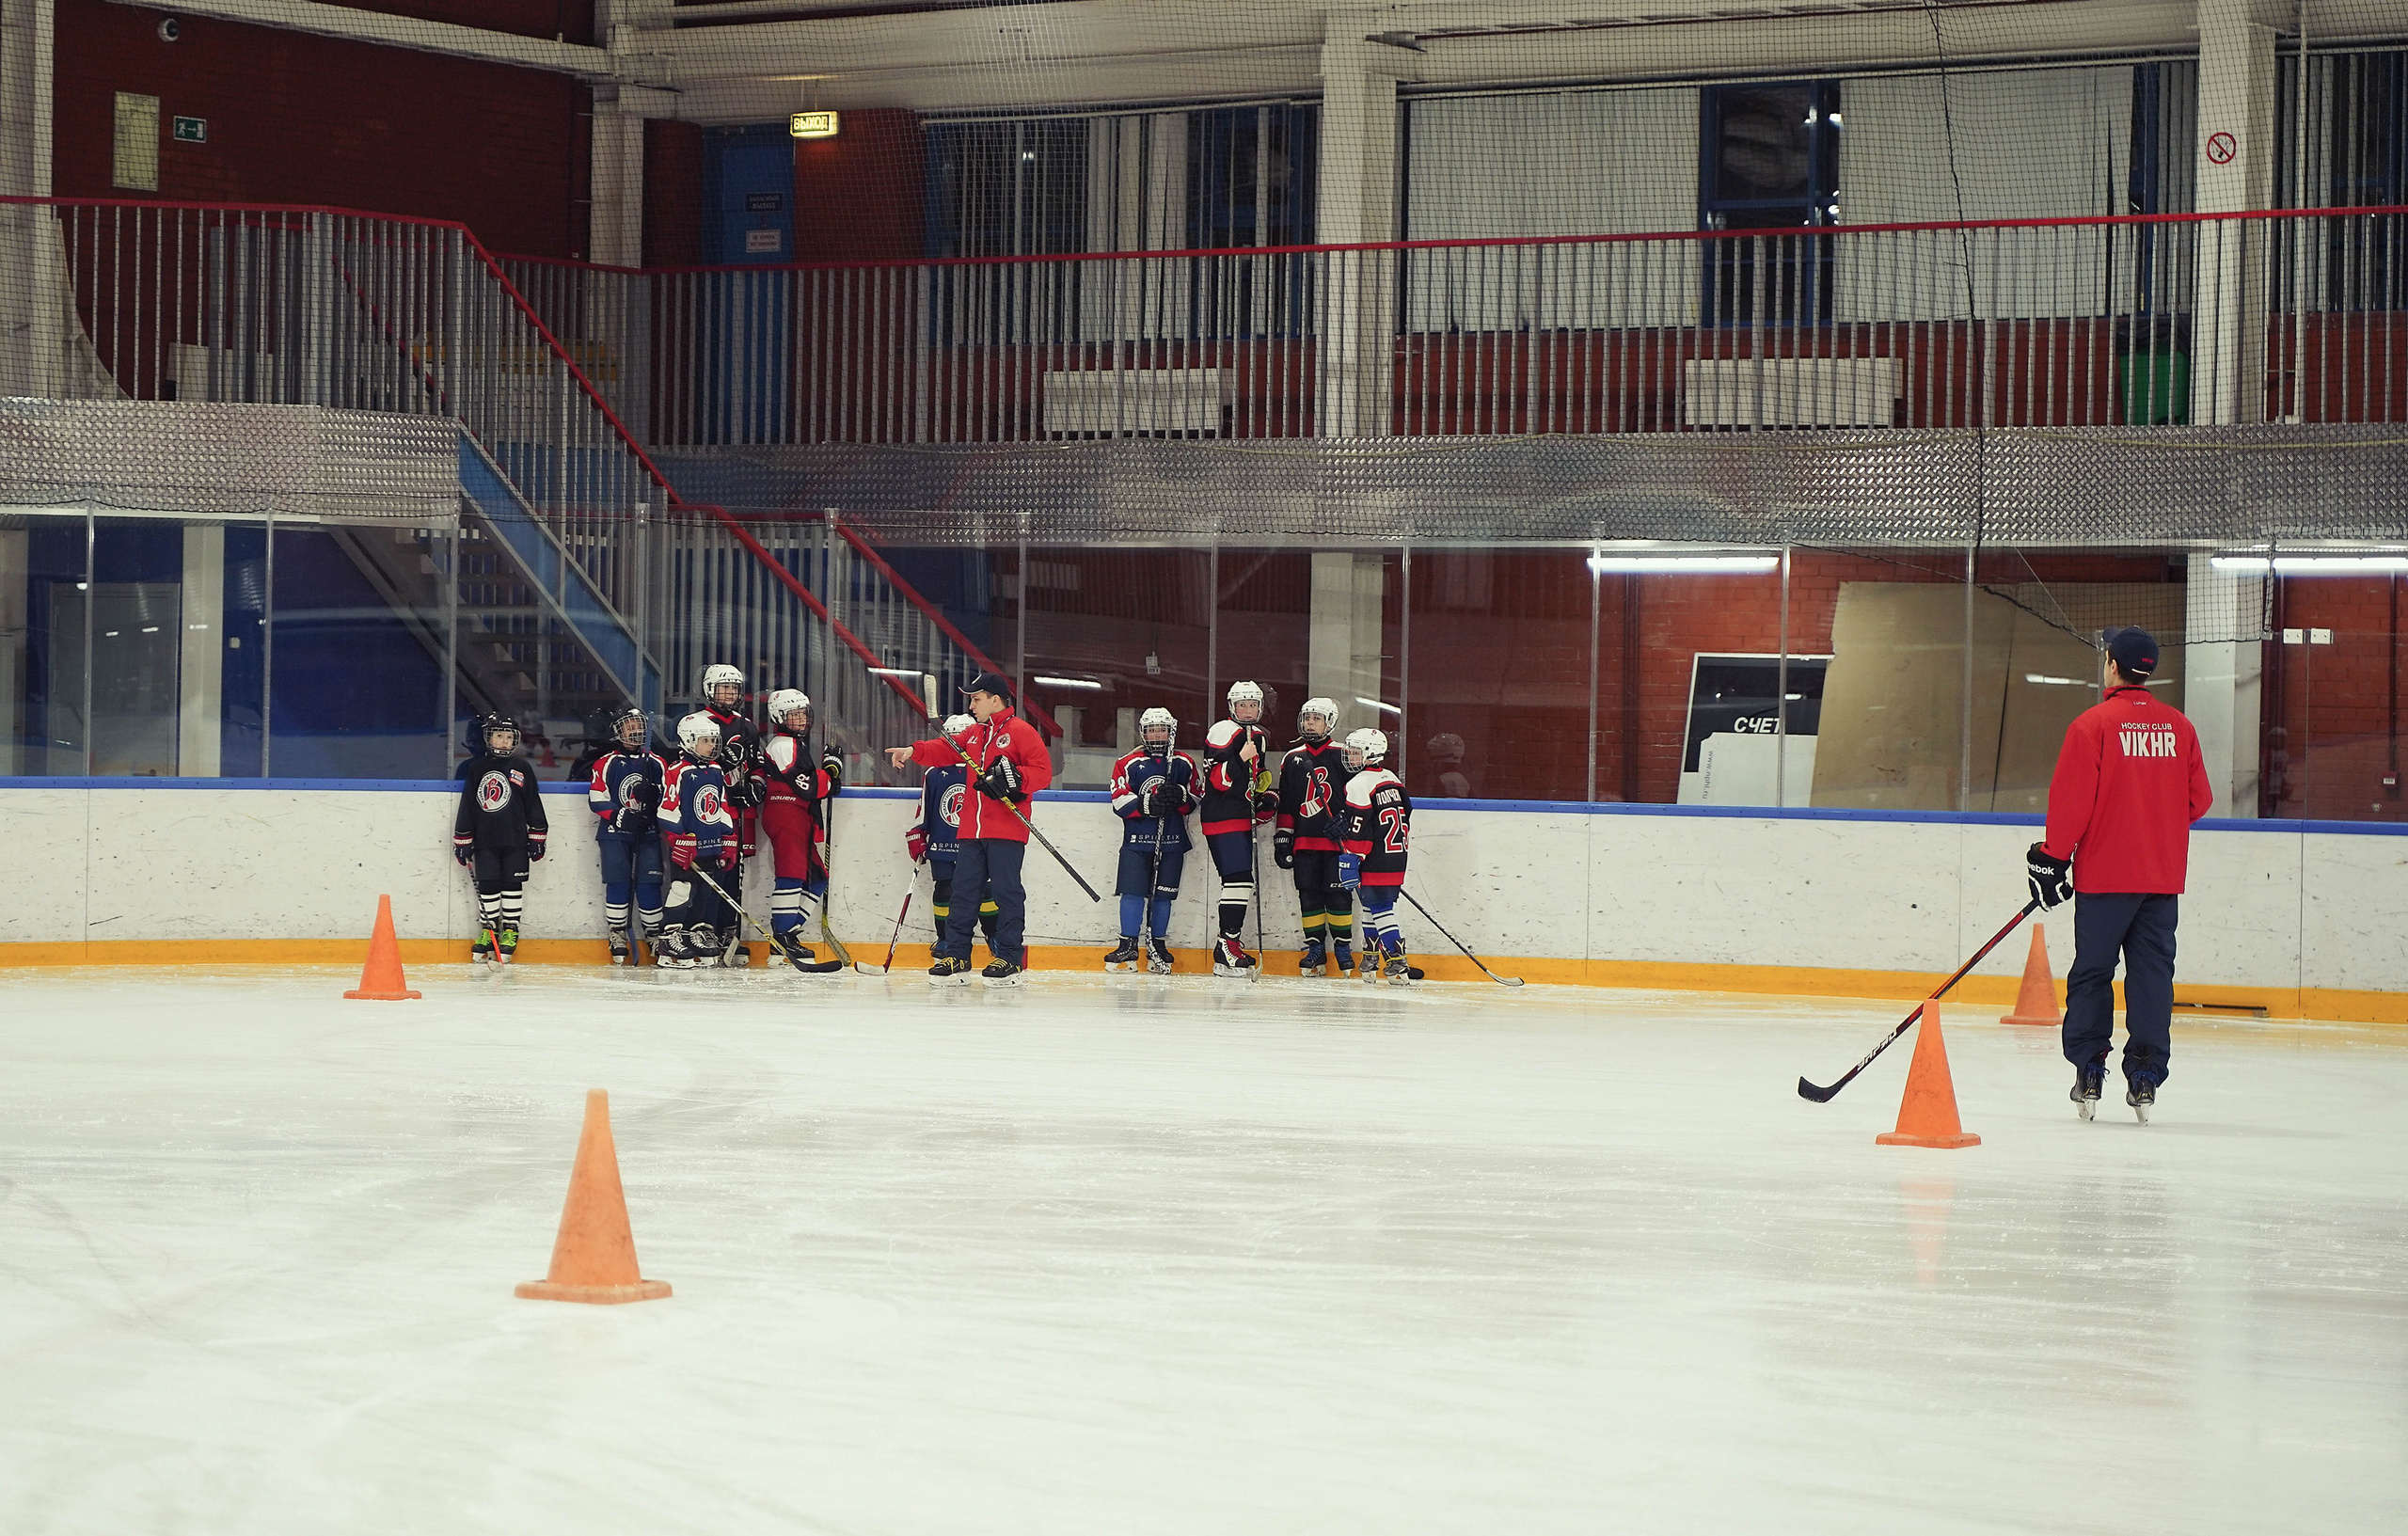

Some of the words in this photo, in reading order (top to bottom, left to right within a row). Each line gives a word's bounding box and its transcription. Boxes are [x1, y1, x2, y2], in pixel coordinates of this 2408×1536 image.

[793, 116, 828, 131] ВЫХОД
[2118, 731, 2177, 757] VIKHR
[1703, 750, 1714, 800] www.nphl.ru
